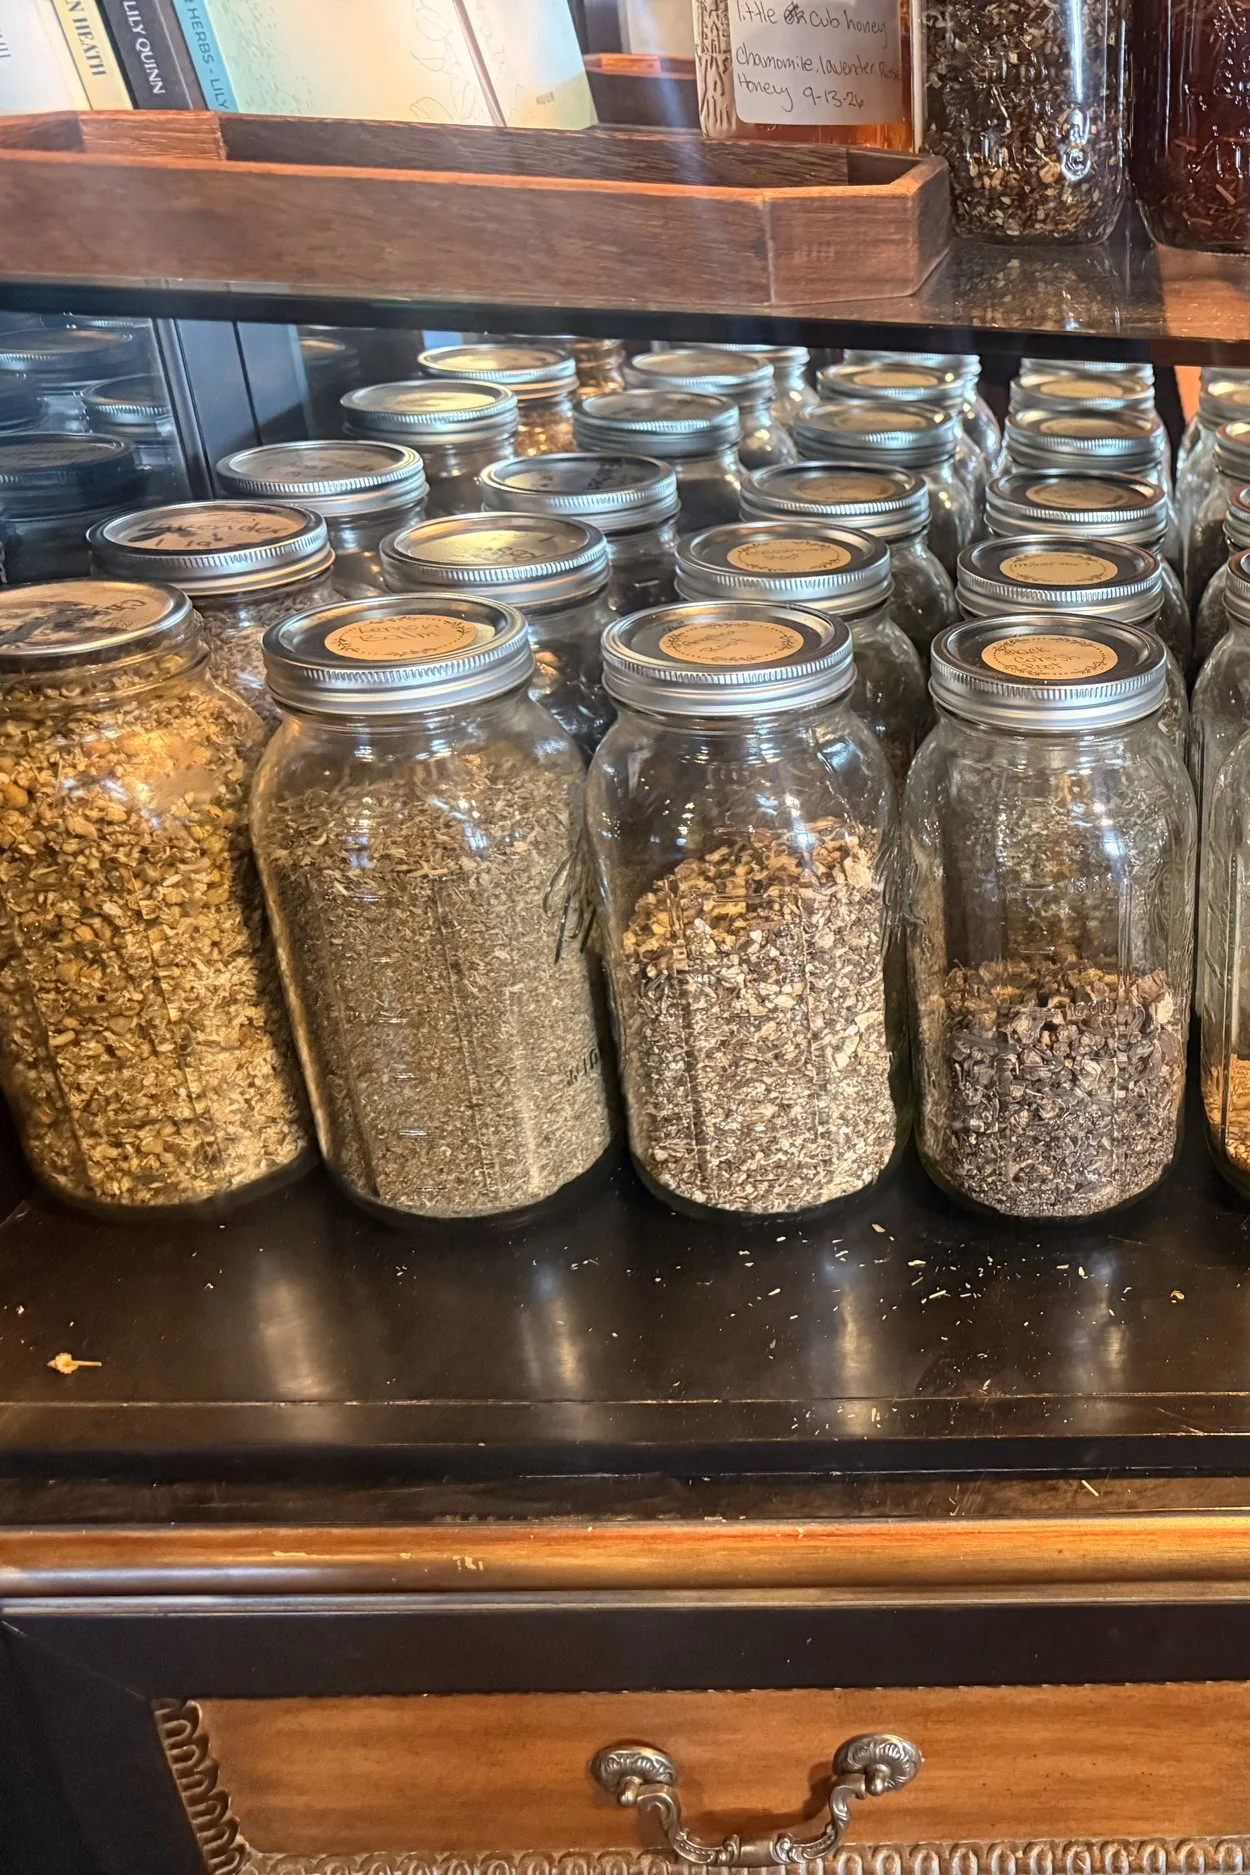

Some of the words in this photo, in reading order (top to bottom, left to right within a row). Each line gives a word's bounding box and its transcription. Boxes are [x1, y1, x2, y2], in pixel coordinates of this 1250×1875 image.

[122, 1, 147, 35] LILY
[843, 9, 889, 49] honey
[71, 17, 107, 77] HEATH
[134, 37, 167, 95] QUINN
[187, 8, 214, 64] HERBS
[210, 77, 230, 110] LILY
[737, 72, 794, 113] Honey
[358, 623, 440, 635] Lemon
[359, 631, 440, 643] Balm
